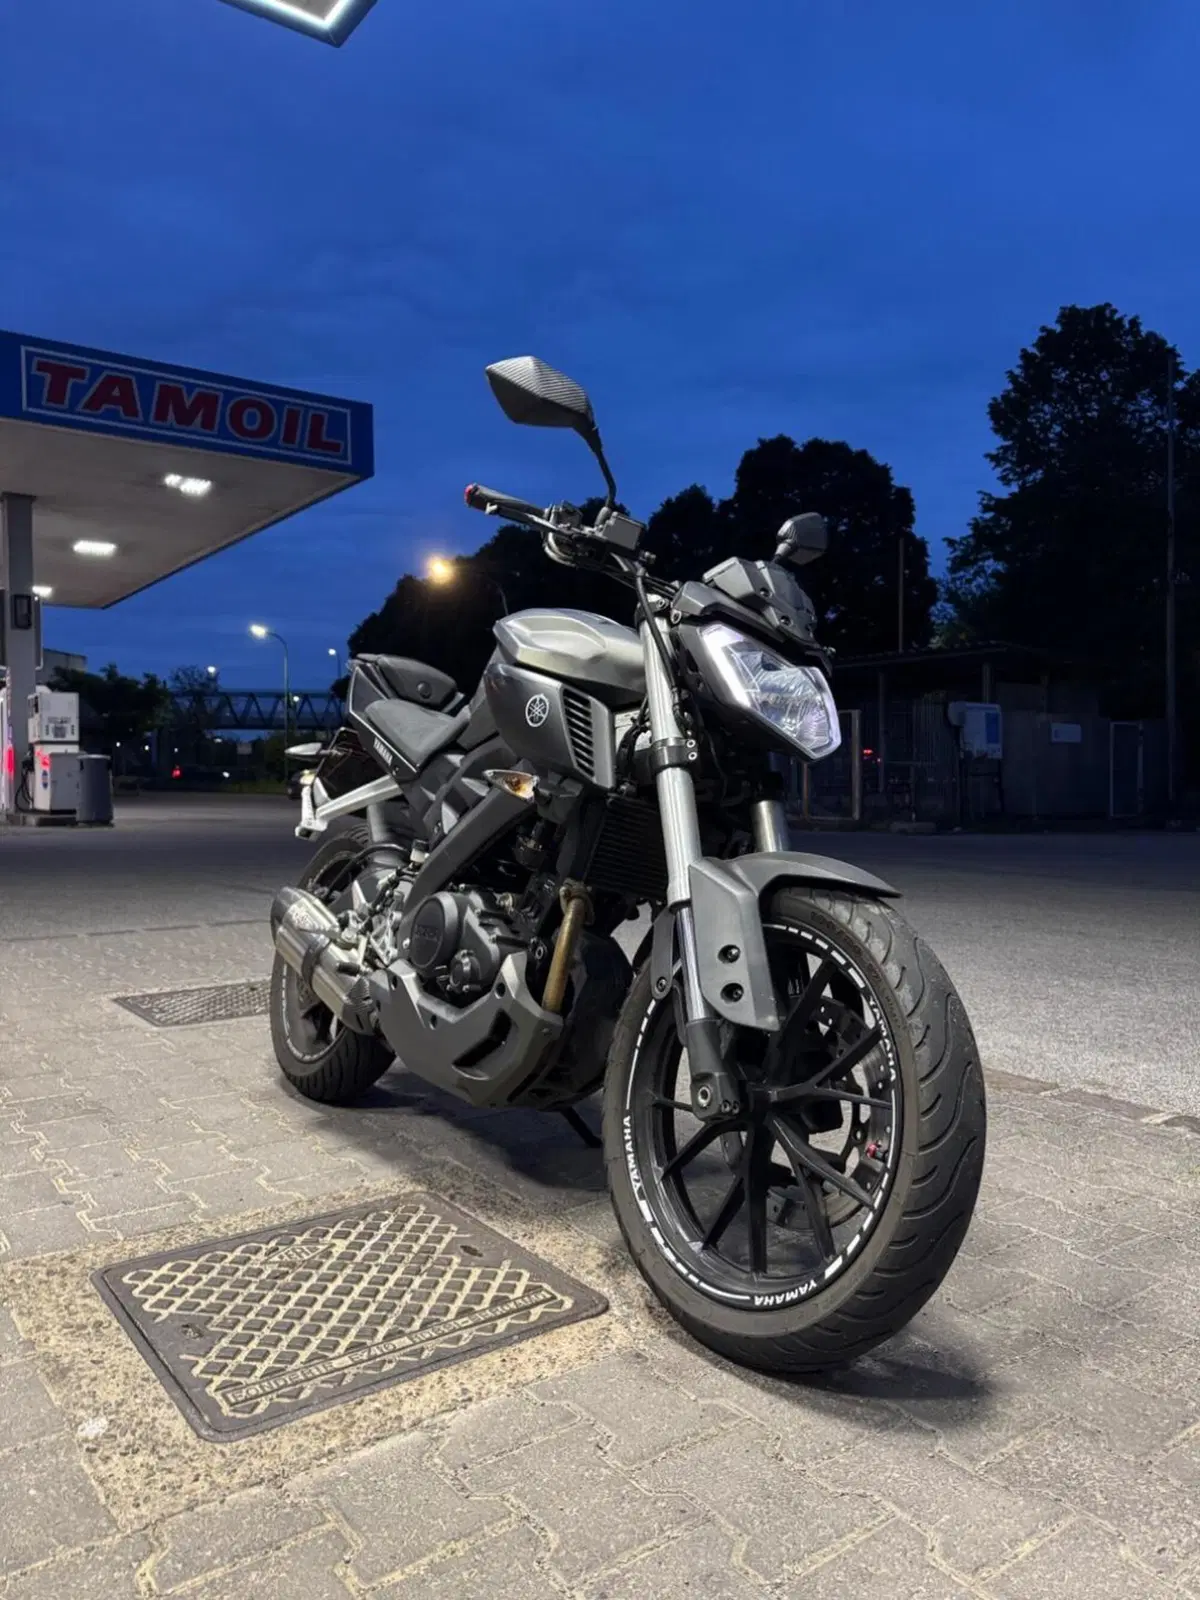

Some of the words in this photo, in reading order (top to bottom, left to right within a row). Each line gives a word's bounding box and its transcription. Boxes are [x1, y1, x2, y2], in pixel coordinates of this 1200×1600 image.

[32, 356, 345, 453] TAMOIL
[623, 1115, 642, 1191] YAMAHA
[754, 1279, 817, 1306] YAMAHA
